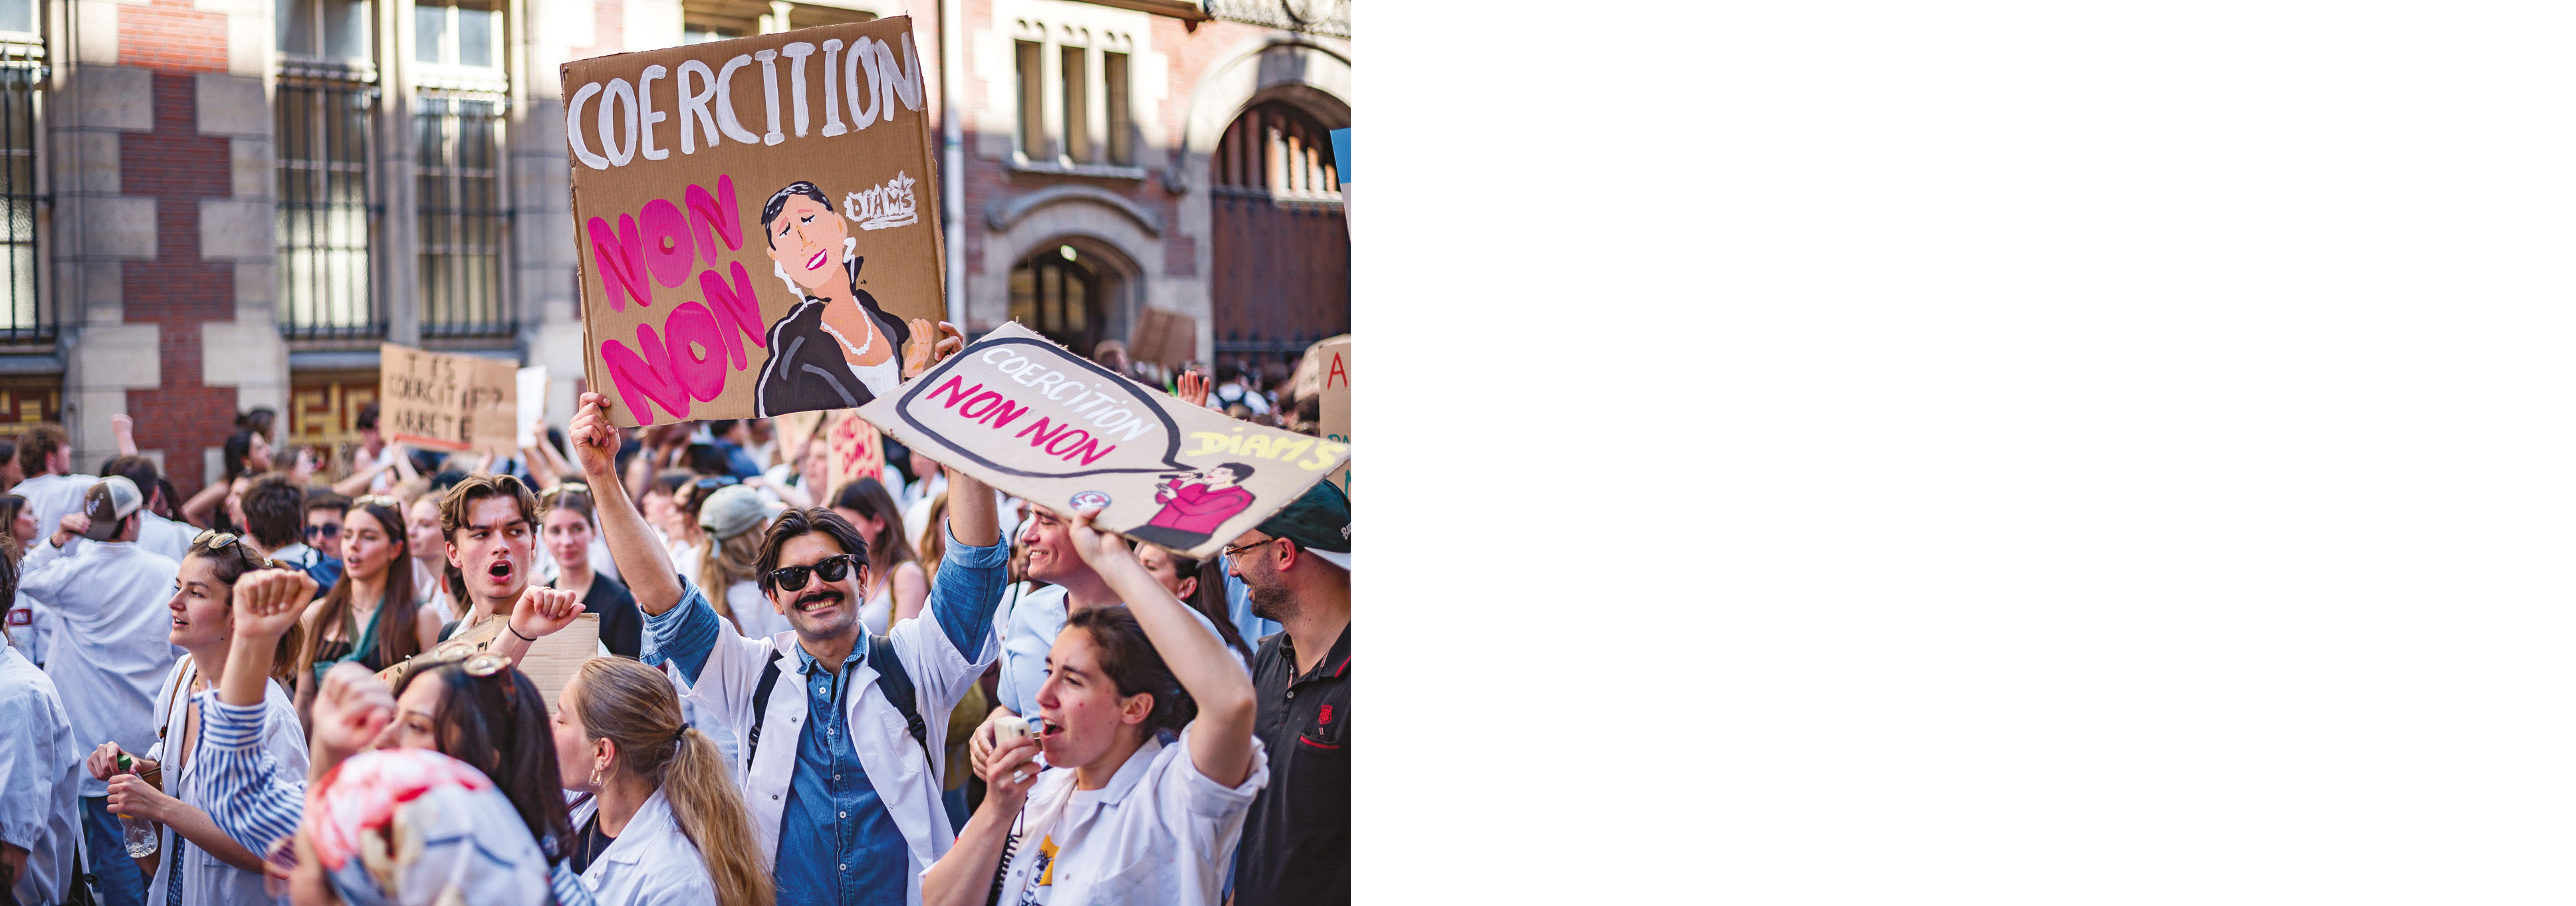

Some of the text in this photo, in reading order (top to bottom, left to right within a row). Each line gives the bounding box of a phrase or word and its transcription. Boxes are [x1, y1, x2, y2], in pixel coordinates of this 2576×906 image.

[568, 31, 925, 170] COERCITION
[588, 174, 743, 312] NON
[601, 261, 766, 426] NON
[925, 375, 1116, 466] NON NON
